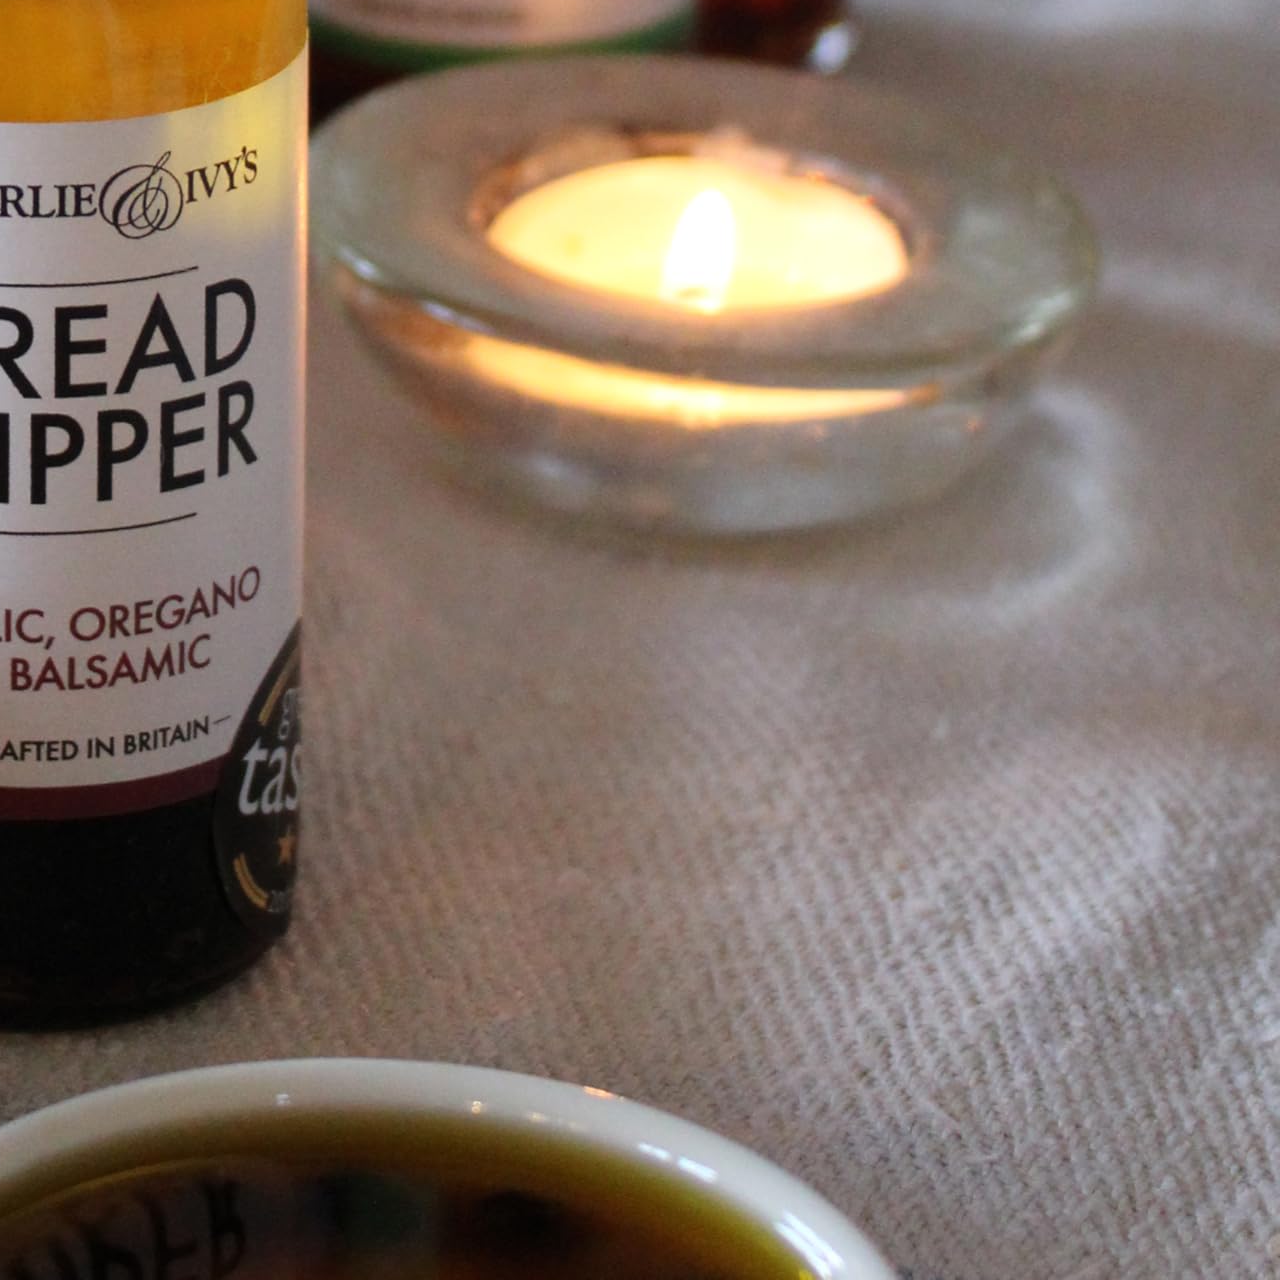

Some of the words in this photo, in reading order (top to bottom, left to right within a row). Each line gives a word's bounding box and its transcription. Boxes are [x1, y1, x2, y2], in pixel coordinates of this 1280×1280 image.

[98, 150, 183, 240] &
[185, 146, 259, 205] IVY'S
[69, 566, 261, 643] OREGANO
[9, 634, 213, 692] BALSAMIC
[86, 736, 115, 759] IN
[123, 716, 211, 756] BRITAIN
